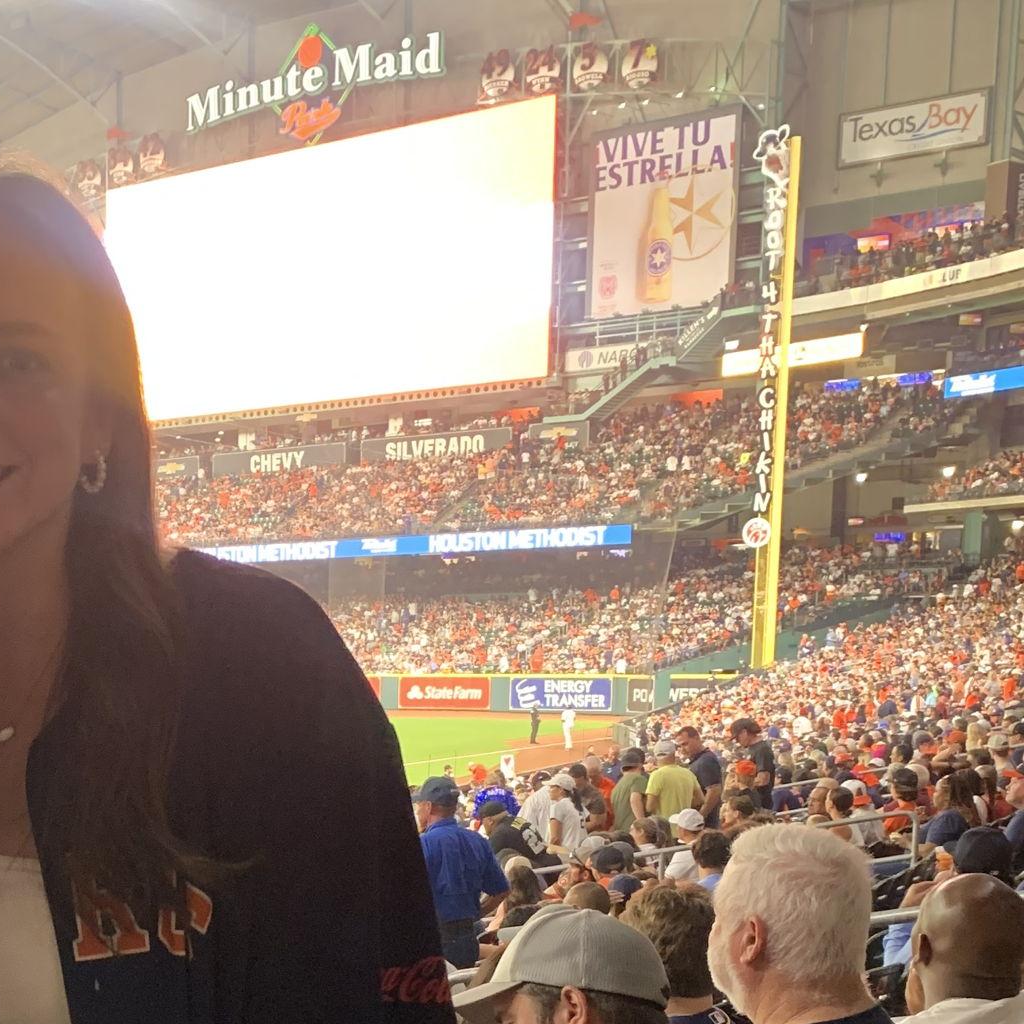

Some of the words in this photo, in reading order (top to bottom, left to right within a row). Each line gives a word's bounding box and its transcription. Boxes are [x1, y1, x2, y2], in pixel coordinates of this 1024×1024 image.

[186, 62, 325, 131] Minute
[332, 32, 442, 87] Maid
[674, 119, 712, 150] TU
[849, 114, 916, 143] Texas
[927, 102, 978, 131] Bay
[596, 141, 736, 191] ESTRELLA!
[385, 434, 485, 460] SILVERADO
[250, 450, 305, 473] CHEVY
[258, 541, 337, 562] METHODIST
[429, 531, 508, 553] HOUSTON
[509, 526, 607, 550] METHODIST
[544, 680, 593, 694] ENERGY
[544, 693, 606, 709] TRANSFER
